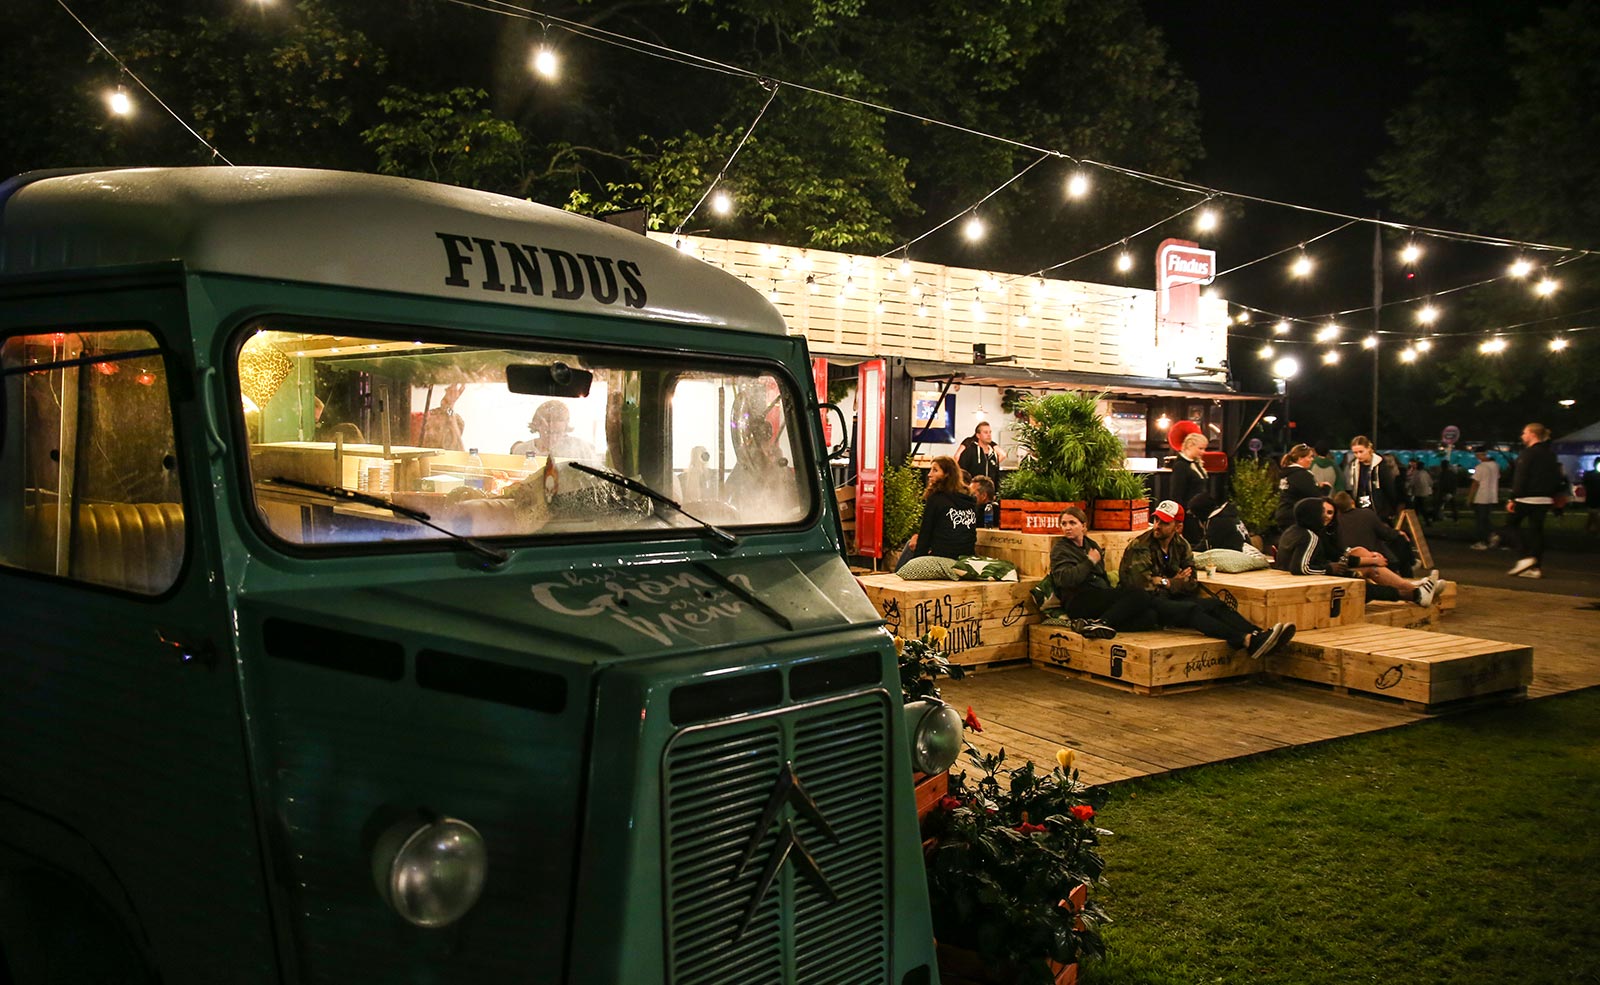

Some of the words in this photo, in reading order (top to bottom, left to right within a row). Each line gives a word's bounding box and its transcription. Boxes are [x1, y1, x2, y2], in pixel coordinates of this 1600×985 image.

[435, 232, 648, 309] FINDUS
[1168, 254, 1209, 275] Findus
[915, 594, 952, 638] PEAS
[955, 604, 972, 620] OUT
